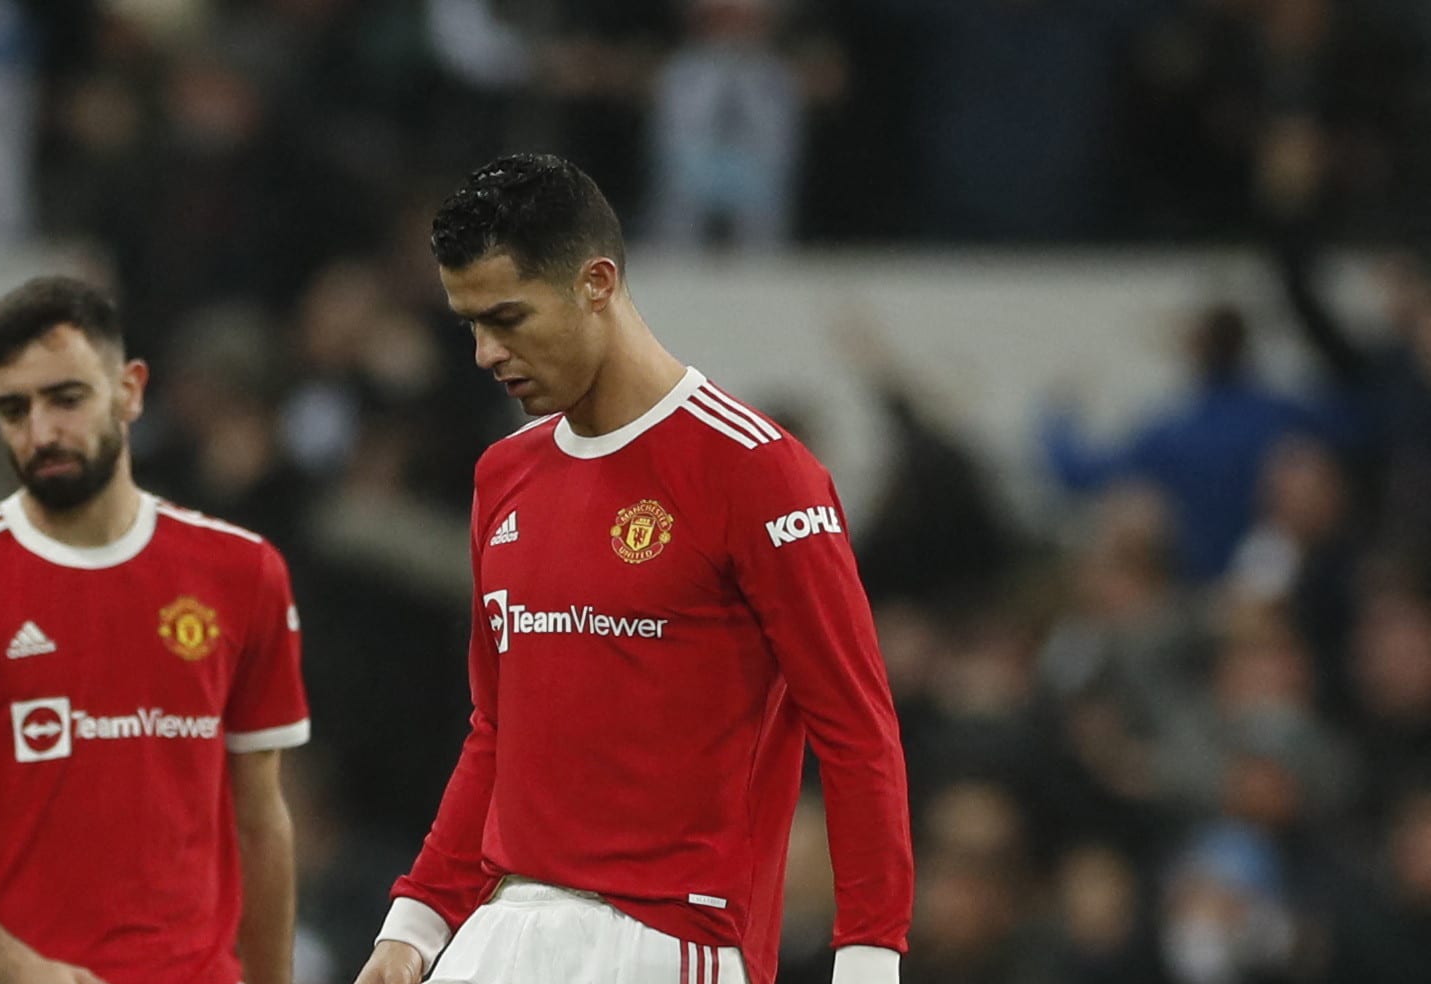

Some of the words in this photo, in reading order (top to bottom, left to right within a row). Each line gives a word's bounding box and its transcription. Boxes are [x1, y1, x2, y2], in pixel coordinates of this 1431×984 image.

[620, 505, 668, 528] MANCHESTER
[618, 546, 653, 560] UNITED
[509, 605, 668, 638] TeamViewer
[71, 708, 221, 739] TeamViewer
